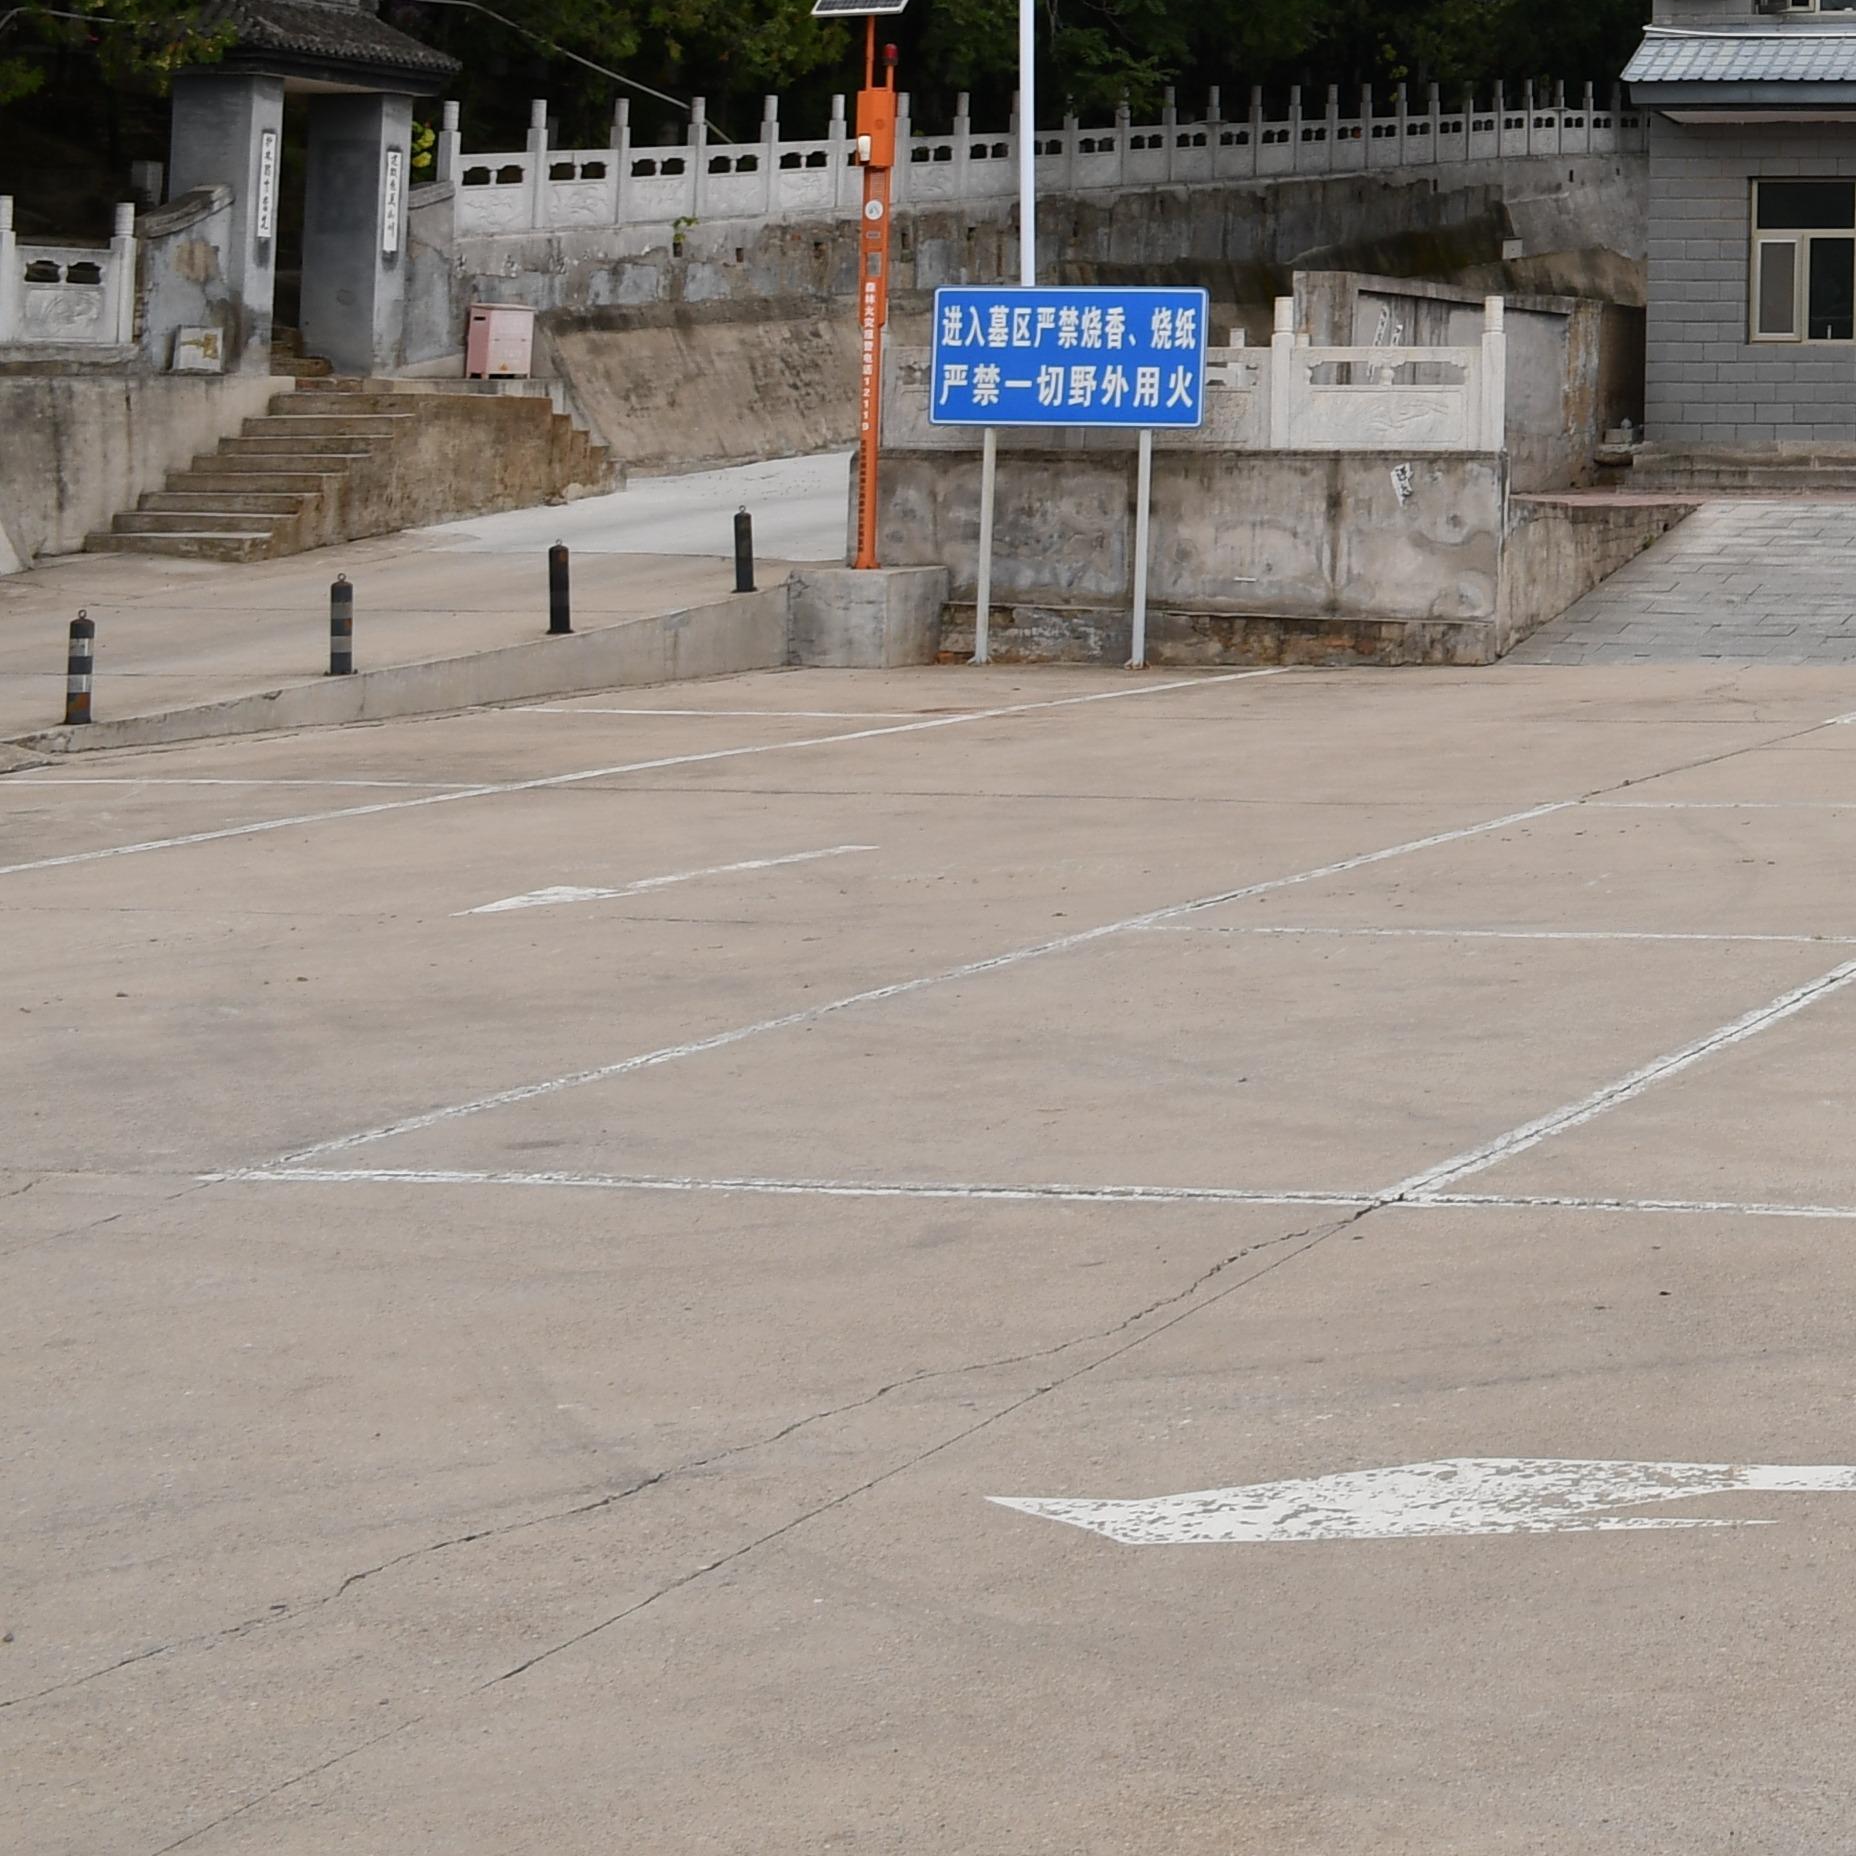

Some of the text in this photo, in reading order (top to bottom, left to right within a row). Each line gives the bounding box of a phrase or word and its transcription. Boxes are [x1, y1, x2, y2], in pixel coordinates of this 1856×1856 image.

[941, 305, 1197, 349] 进入墓区严禁烧香、烧纸
[939, 363, 1194, 408] 严禁一切野外用火
